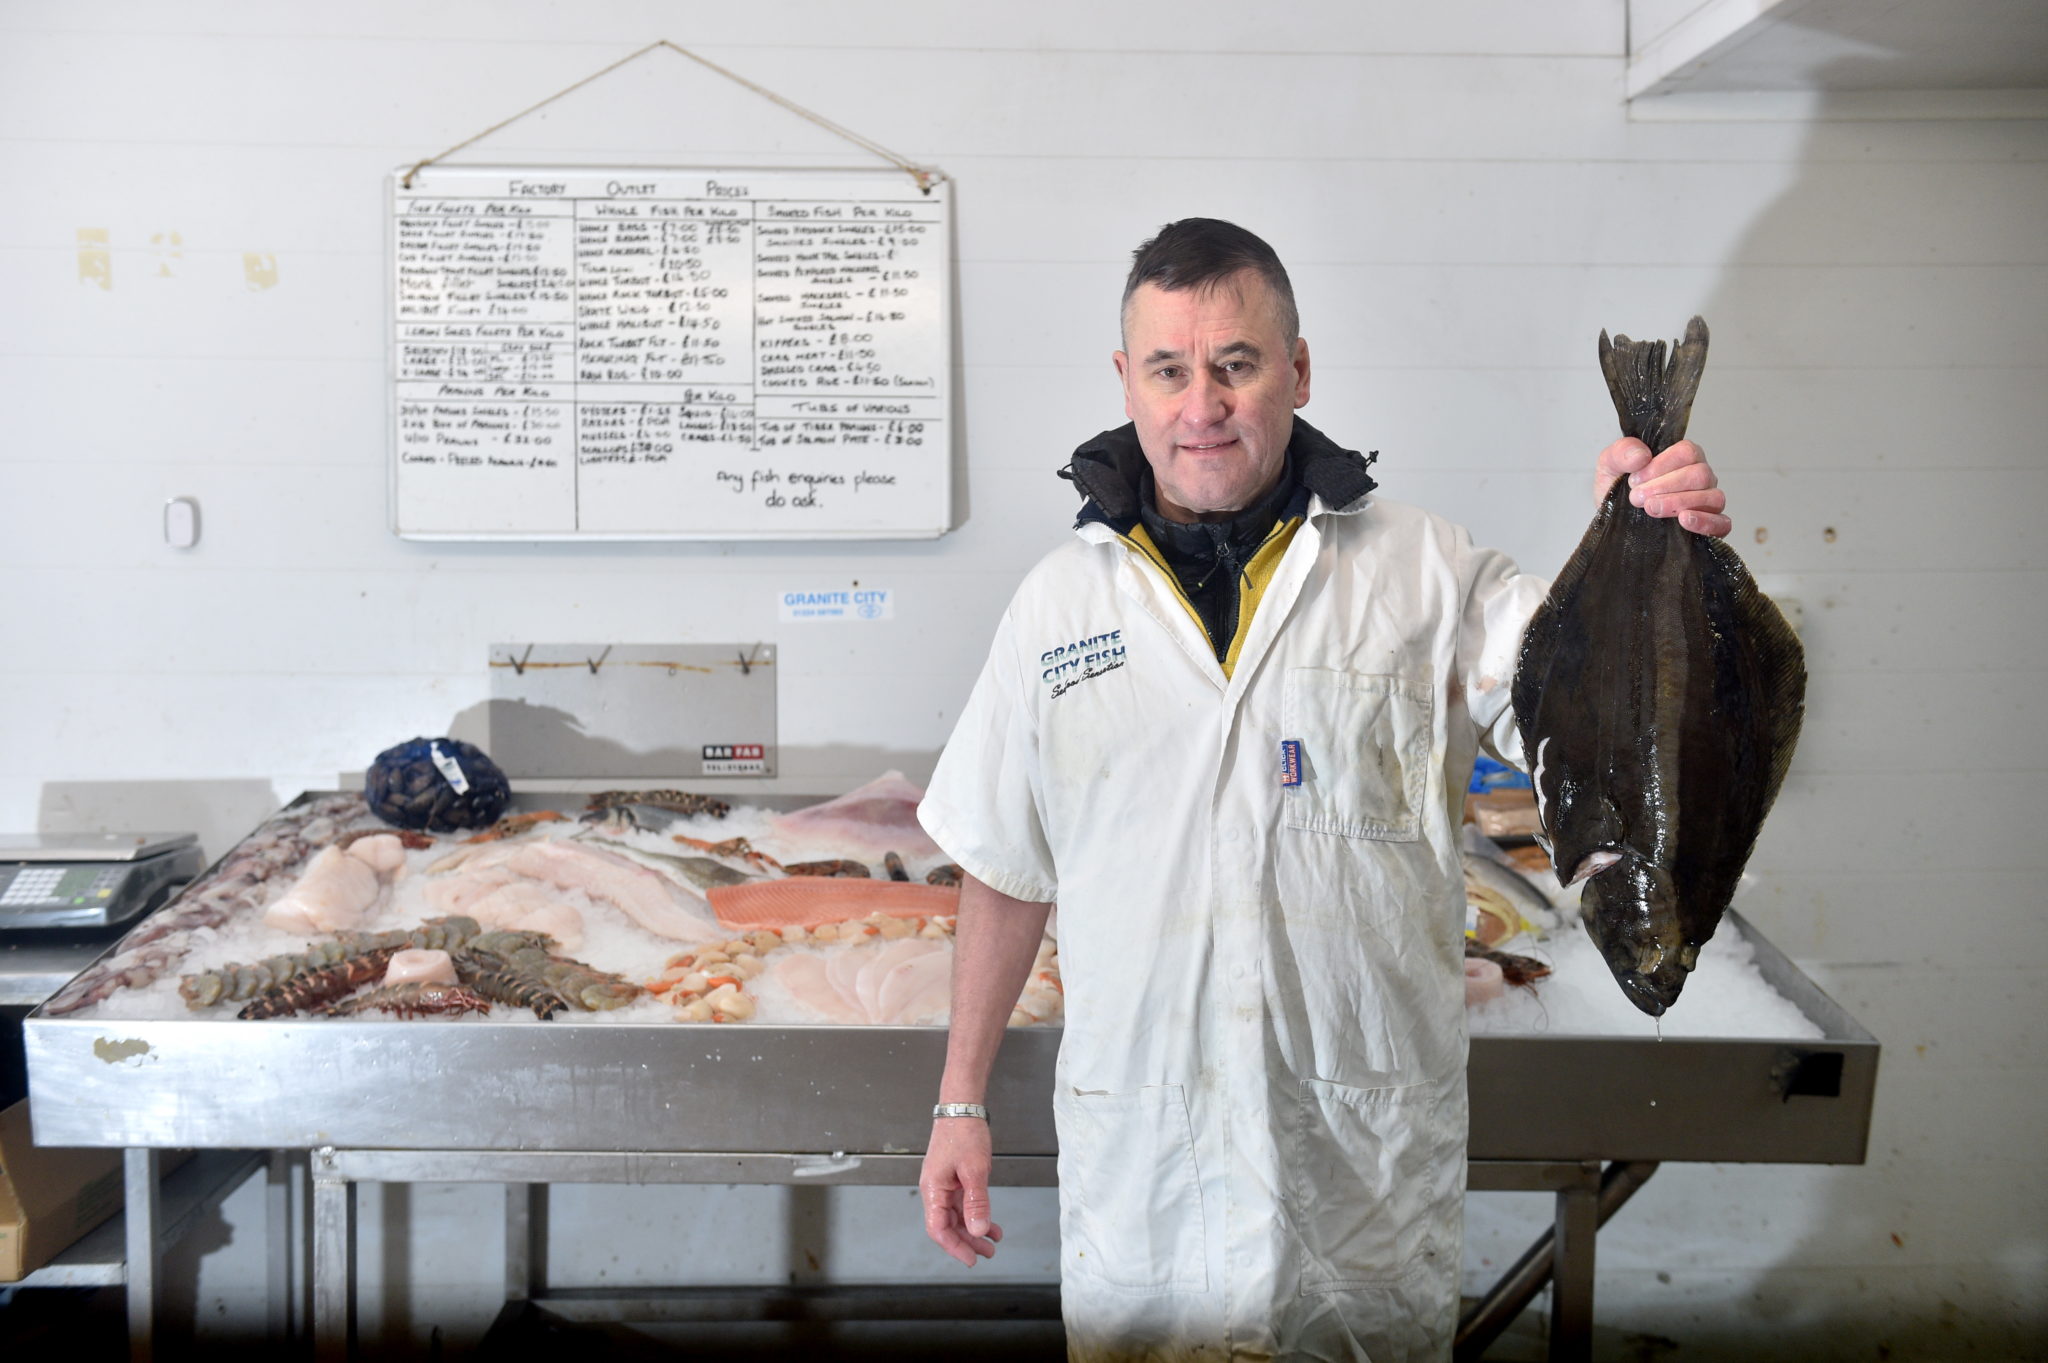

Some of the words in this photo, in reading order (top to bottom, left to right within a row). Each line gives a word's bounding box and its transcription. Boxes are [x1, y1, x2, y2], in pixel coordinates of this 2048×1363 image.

[509, 181, 566, 196] FACTORY
[606, 181, 656, 196] OUTLET
[651, 205, 678, 216] FISH
[684, 207, 704, 216] PER
[813, 206, 842, 217] FISH
[852, 206, 876, 217] PER
[885, 207, 912, 217] KILO
[716, 470, 744, 493] Any
[750, 468, 780, 492] fish
[788, 471, 846, 493] enquiries
[853, 469, 897, 493] please
[765, 488, 787, 509] do
[791, 490, 824, 509] ask.
[784, 591, 849, 606] GRANITE
[853, 591, 887, 604] CITY
[1040, 629, 1121, 666] GRANITE
[1042, 657, 1080, 683] CITY
[1084, 645, 1126, 669] FISH
[1288, 744, 1297, 783] WORKWEAR
